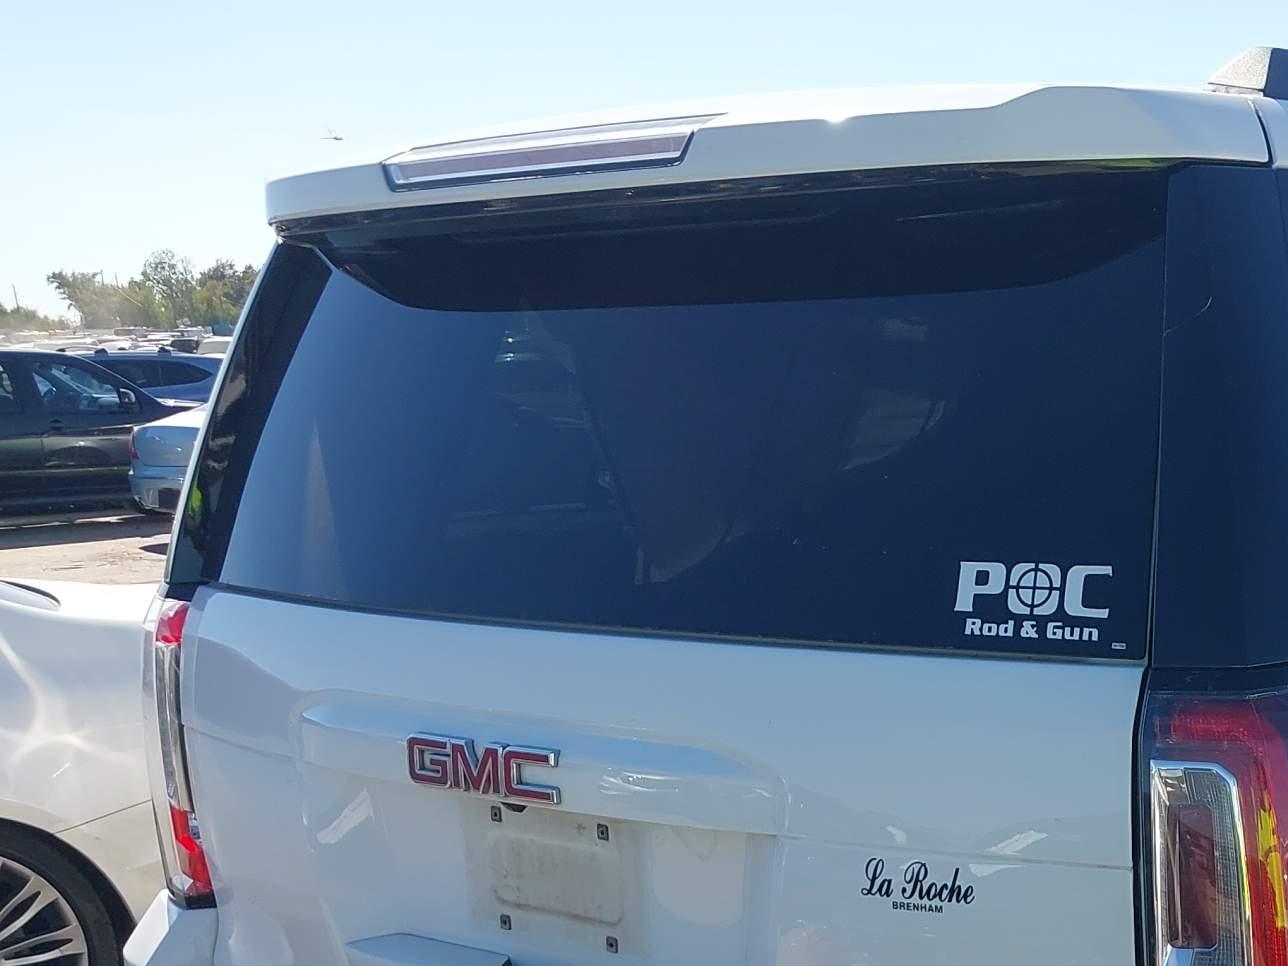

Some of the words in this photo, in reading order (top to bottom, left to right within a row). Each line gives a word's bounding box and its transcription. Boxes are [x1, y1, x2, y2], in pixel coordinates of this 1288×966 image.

[953, 561, 1113, 619] POC
[964, 618, 1014, 637] Rod
[1020, 621, 1039, 639] &
[1046, 622, 1099, 641] Gun
[406, 732, 562, 806] GMC
[860, 857, 893, 898] La
[901, 861, 976, 905] Roche
[892, 900, 944, 914] BRENHAM
